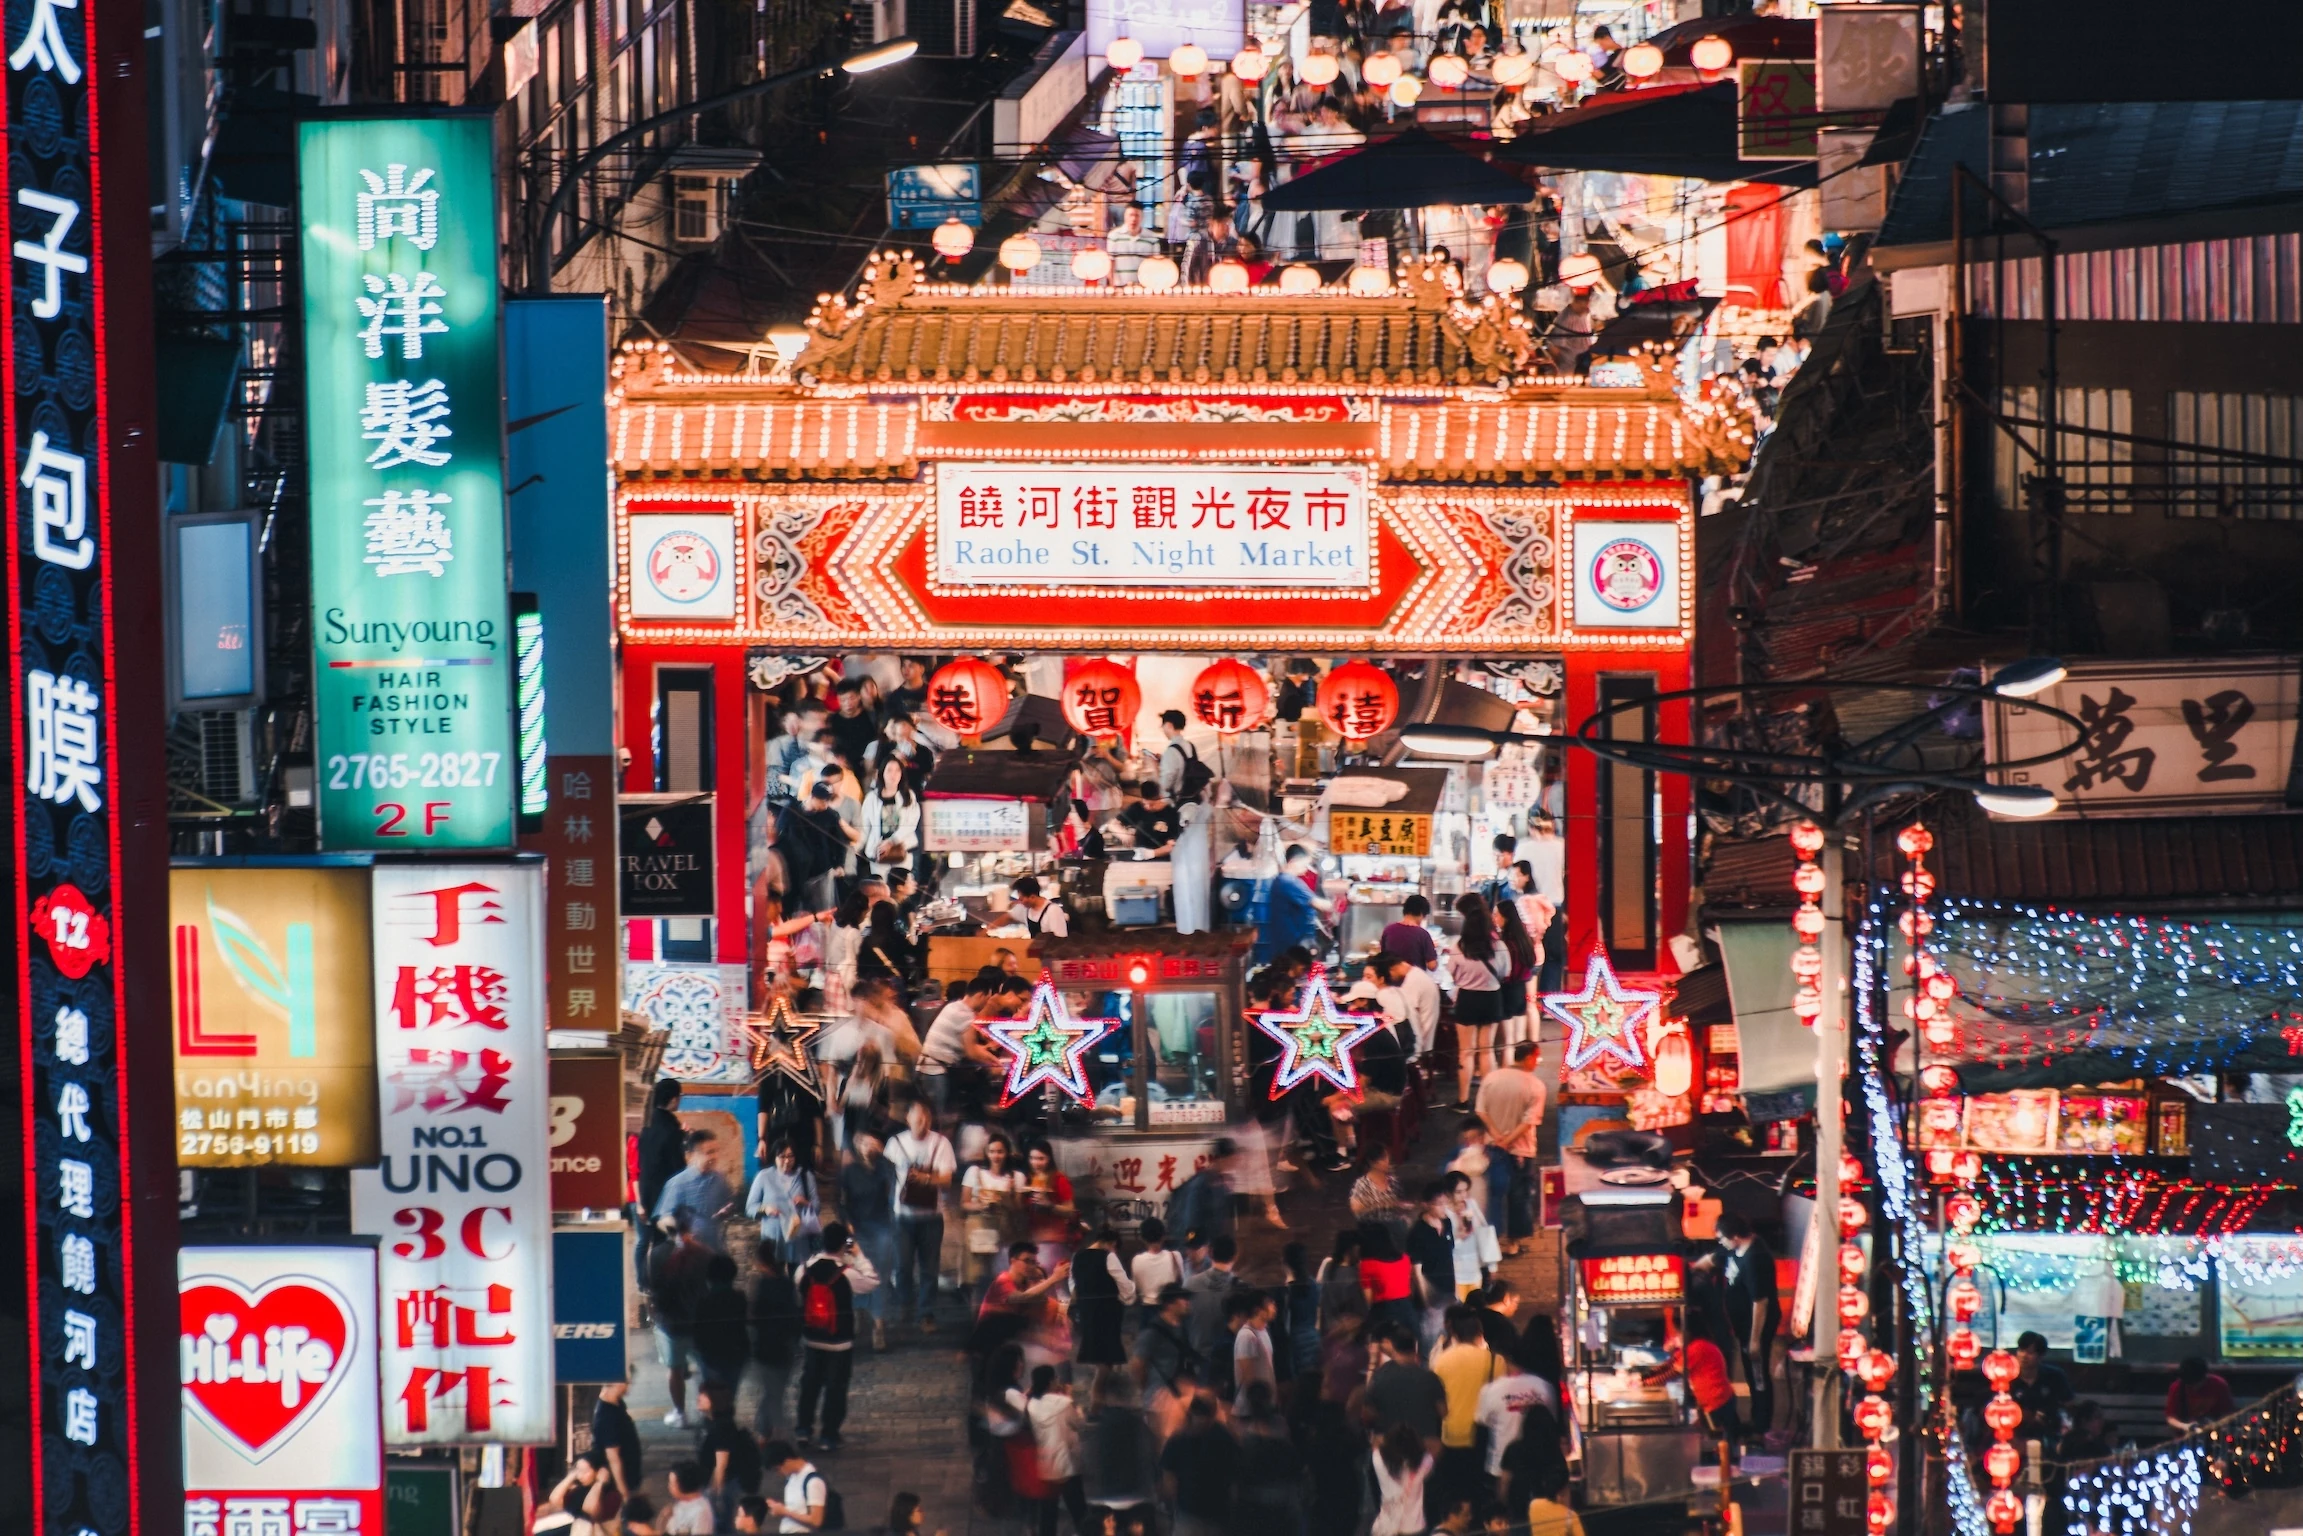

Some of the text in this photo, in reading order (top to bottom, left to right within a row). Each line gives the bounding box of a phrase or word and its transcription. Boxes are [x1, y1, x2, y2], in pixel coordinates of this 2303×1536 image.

[357, 163, 454, 578] 尚洋髮藝
[9, 0, 101, 813] 太子包膜
[958, 485, 1351, 532] 饒河街觀光夜市
[955, 540, 1355, 574] Raohe St. Night Market
[325, 608, 497, 652] Sunyoung
[379, 672, 441, 689] HAIR
[352, 694, 468, 712] FASHION
[370, 717, 452, 735] STYLE
[2063, 686, 2256, 792] 萬里
[328, 752, 501, 790] 2765-2827
[373, 802, 452, 837] 2F
[1359, 817, 1415, 842] 臭豆腐
[562, 771, 598, 1018] 哈林運動世界
[632, 873, 679, 891] FOX
[386, 881, 513, 1116] 手機殼
[180, 1107, 318, 1130] 松山門市部
[413, 1127, 488, 1149] NO.1
[180, 1132, 319, 1155] 2756-9119
[382, 1154, 522, 1194] UNO
[55, 1006, 97, 1446] 總代理饒河店
[392, 1206, 516, 1264] 3C
[553, 1323, 617, 1339] ERS
[180, 1314, 334, 1408] Hi-Life
[394, 1283, 516, 1433] 配件
